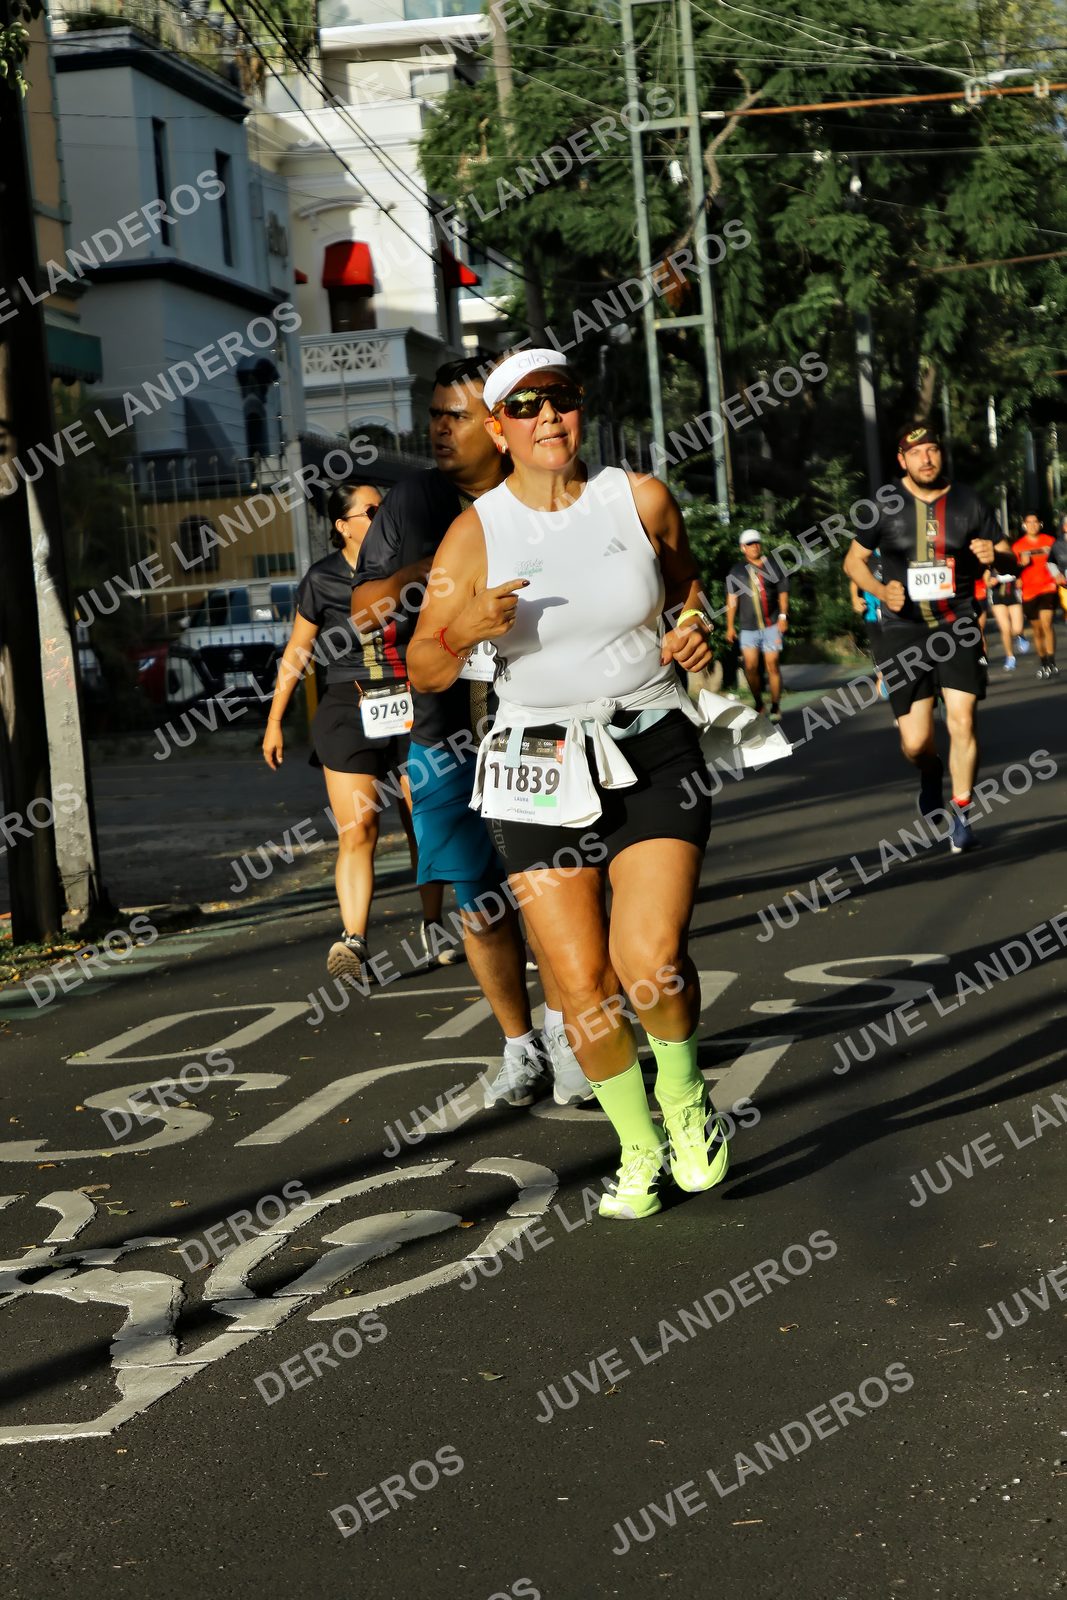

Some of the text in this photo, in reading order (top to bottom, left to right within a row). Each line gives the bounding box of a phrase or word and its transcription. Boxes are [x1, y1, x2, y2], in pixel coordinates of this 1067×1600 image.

[915, 572, 946, 586] 8019
[370, 700, 409, 720] 9749
[489, 762, 560, 795] 11839
